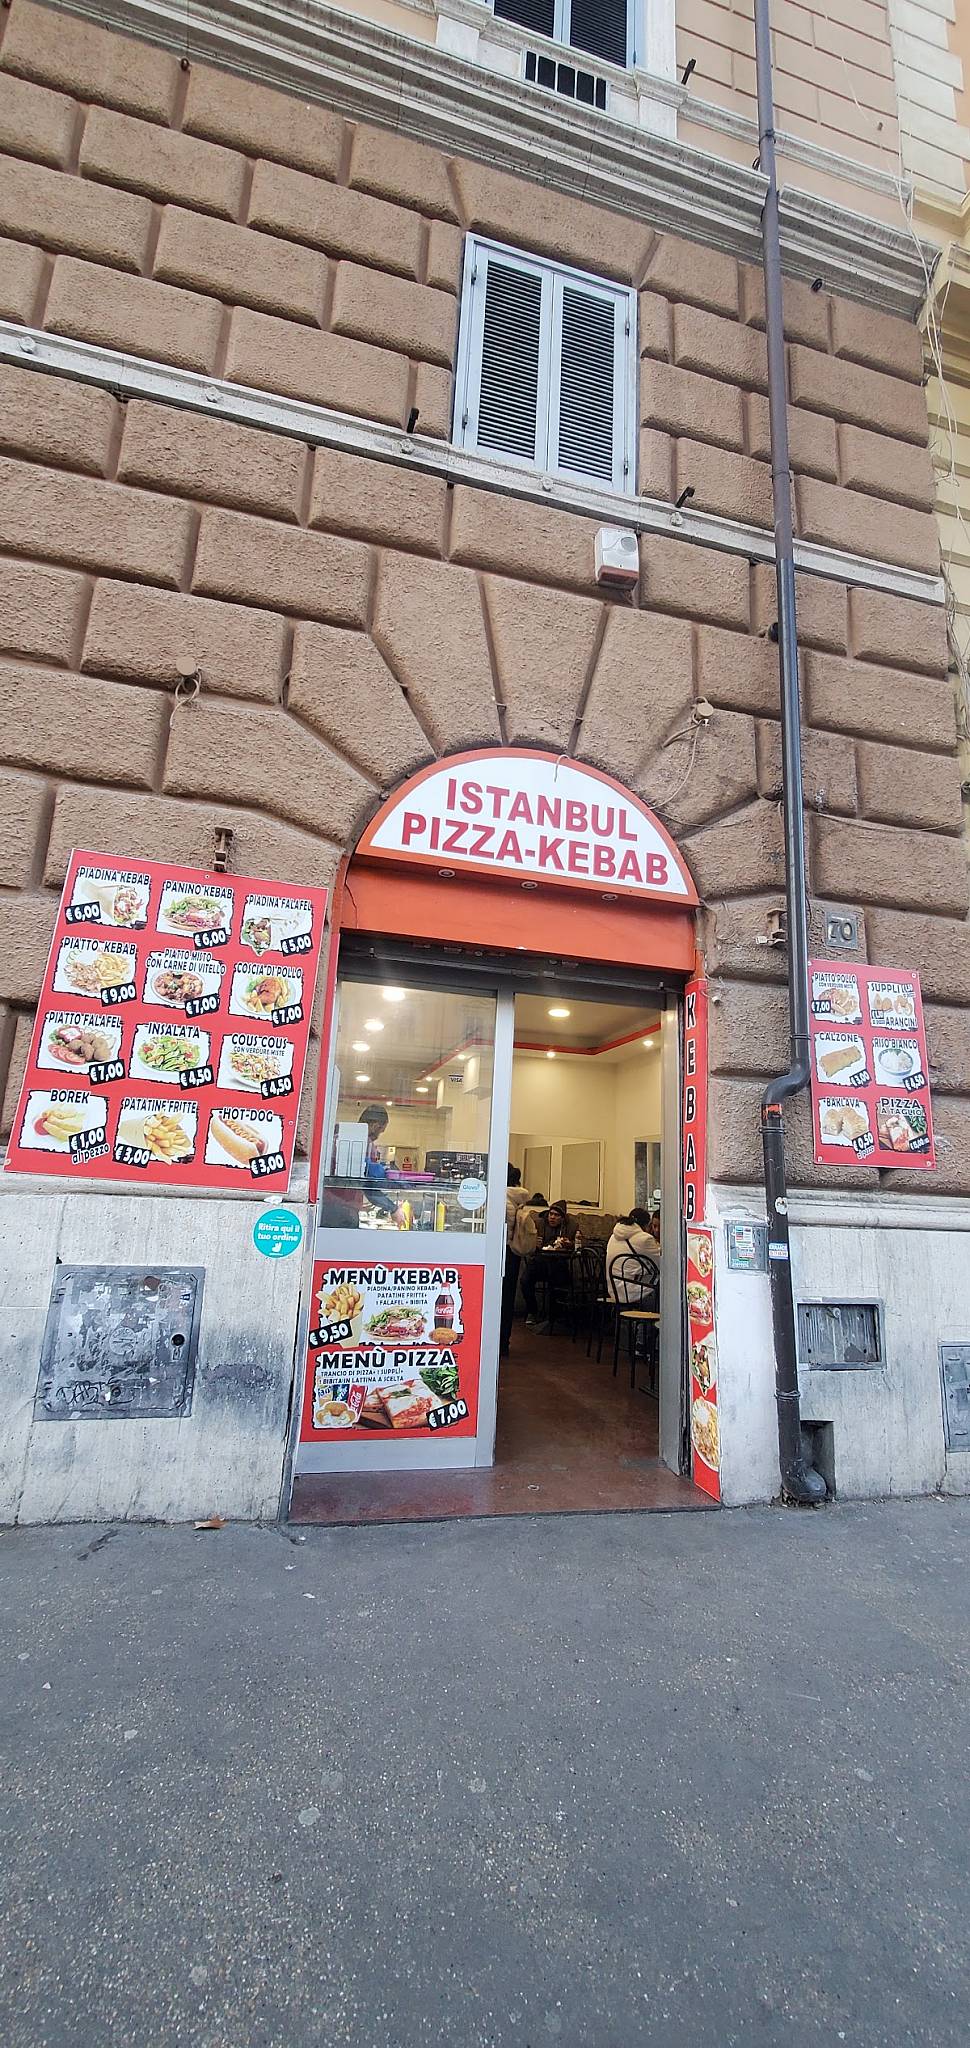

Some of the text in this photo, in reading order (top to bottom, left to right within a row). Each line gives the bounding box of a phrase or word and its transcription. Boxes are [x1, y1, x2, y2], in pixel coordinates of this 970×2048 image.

[447, 778, 637, 841] ISTANBUL
[402, 812, 668, 886] PIZZA-KEBAB
[79, 867, 150, 885] PIADINA KEBAB
[165, 881, 233, 899] PANINO KEBAB
[249, 895, 311, 911] PIADINA FALAFEL
[828, 919, 853, 941] 70
[63, 937, 136, 955] PIATTO KEBAB
[164, 949, 211, 962] PIATTO MISTO
[147, 958, 226, 975] CON CARNE DI VITELLO
[237, 963, 302, 979] COSCIA DI POLLO
[815, 973, 856, 984] PIATTO POLLO
[49, 1012, 121, 1028] PIATTO FALAFEL
[148, 1023, 200, 1038] INSALATA
[819, 1032, 859, 1043] CALZONE
[232, 1034, 286, 1049] COUS COUS
[875, 1038, 918, 1049] RISO BIANCO
[51, 1090, 89, 1103] BOREK
[827, 1097, 860, 1108] BAKLAVA
[881, 1098, 921, 1109] PIZZA
[124, 1099, 197, 1113] PATATINE FRITTE
[685, 993, 697, 1222] KEBAB
[891, 1108, 922, 1116] TAGLIO
[222, 1107, 273, 1122] HOT-DOG
[72, 1145, 109, 1163] al pezzo
[258, 1223, 279, 1231] Ritira
[281, 1225, 293, 1234] qui
[272, 1233, 298, 1241] ordine
[330, 1265, 457, 1285] MENÙ KEBAB
[322, 1348, 454, 1369] MENÙ PIZZA
